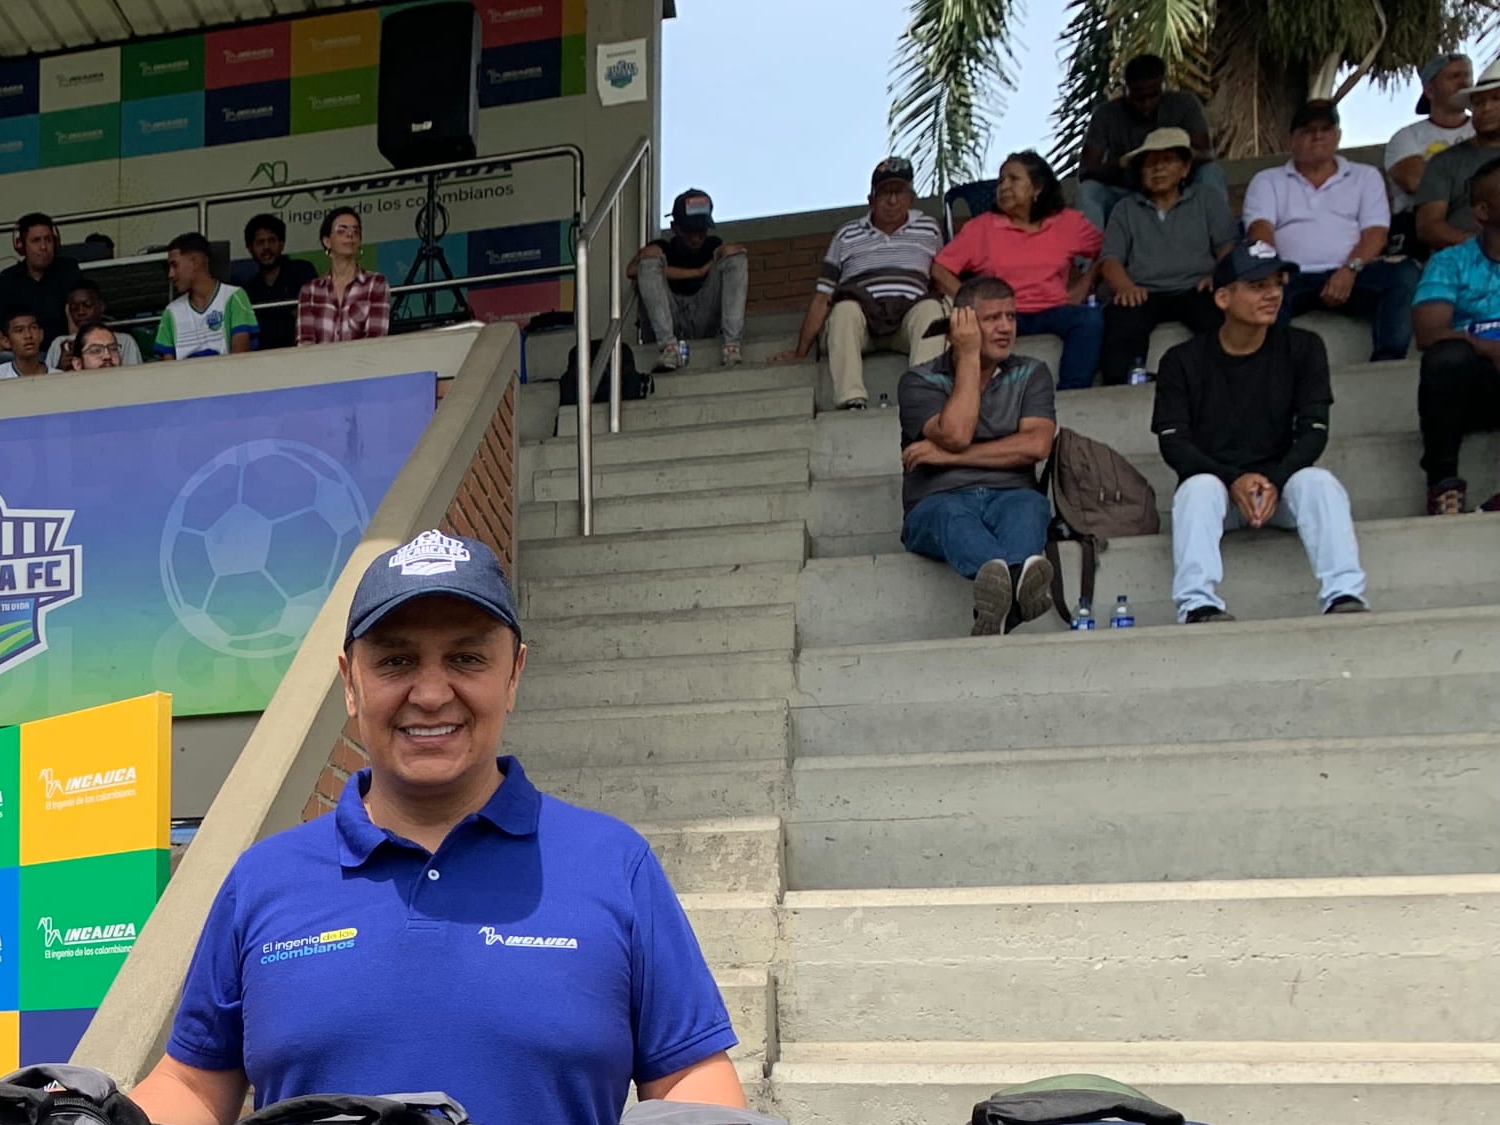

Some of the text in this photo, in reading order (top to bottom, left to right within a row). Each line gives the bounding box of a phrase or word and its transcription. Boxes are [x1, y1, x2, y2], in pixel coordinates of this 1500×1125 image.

[27, 560, 61, 589] FC
[65, 767, 137, 791] INCAUCA
[64, 923, 136, 942] INCAUCA
[263, 930, 354, 954] El ingenio de los
[505, 935, 578, 948] INCAUCA
[260, 939, 355, 965] colombianos
